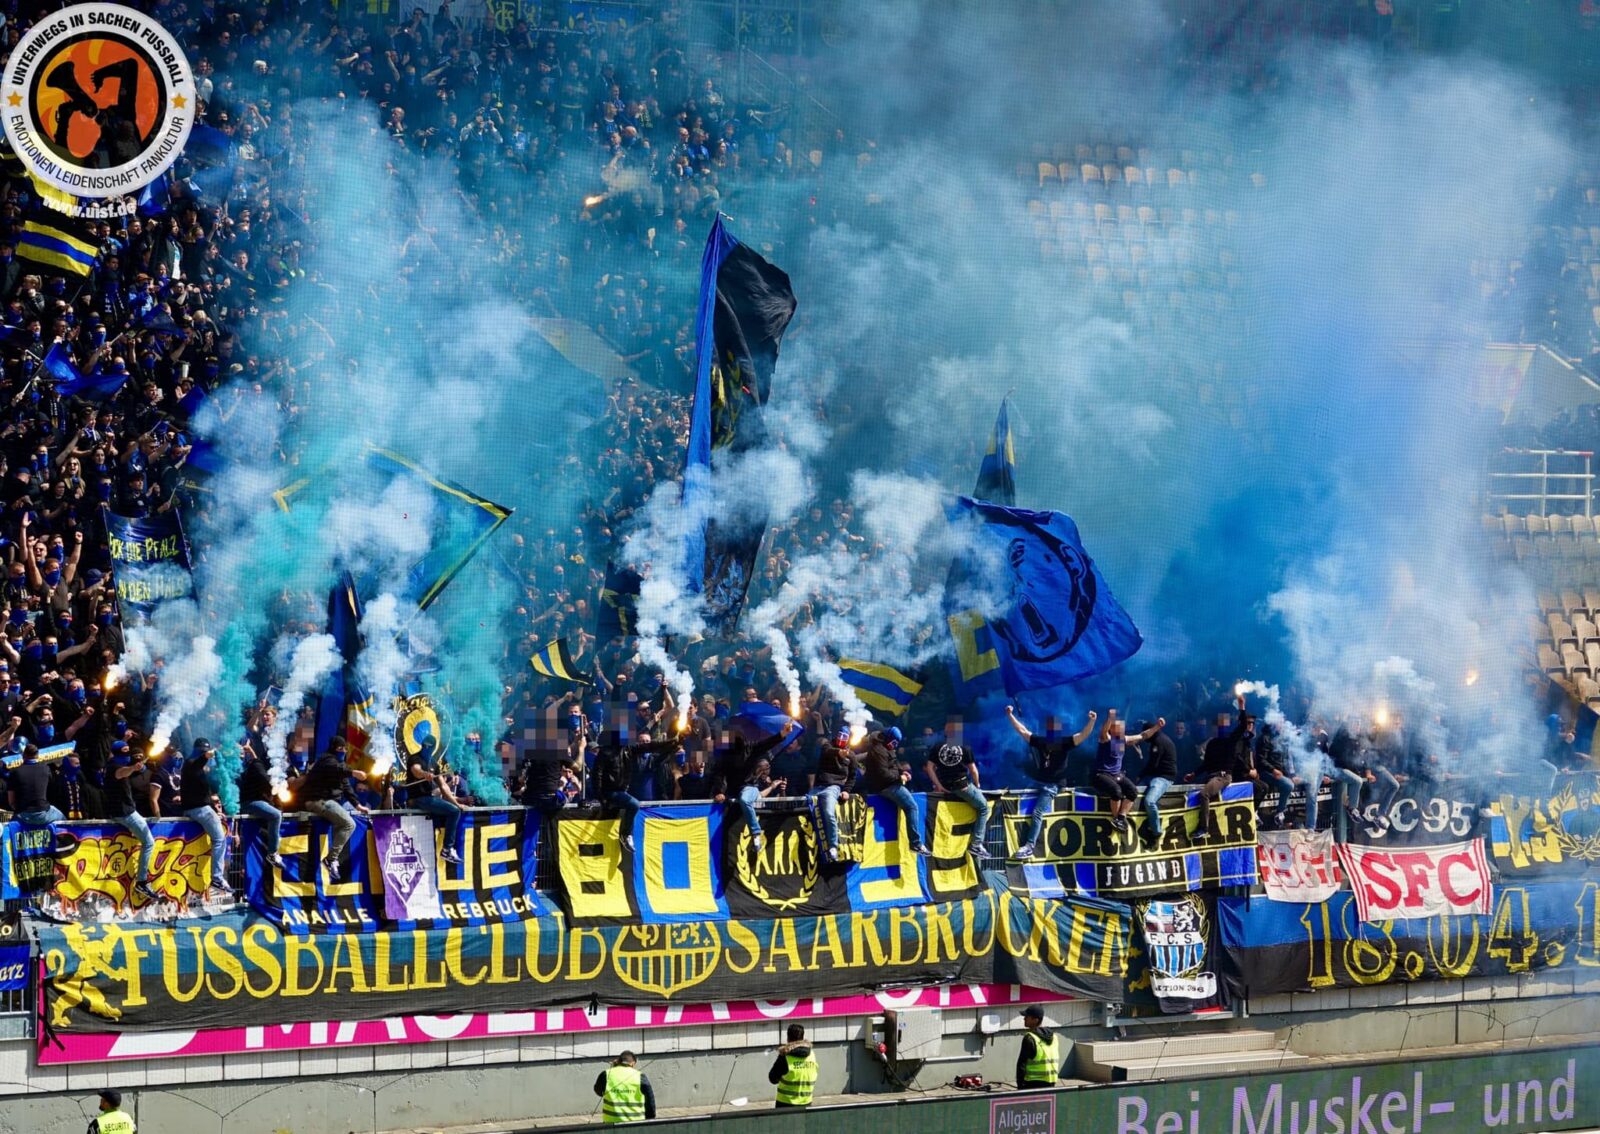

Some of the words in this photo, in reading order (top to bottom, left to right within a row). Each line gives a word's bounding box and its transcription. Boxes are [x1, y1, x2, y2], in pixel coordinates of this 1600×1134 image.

[1361, 797, 1476, 839] SC95
[387, 862, 424, 873] AUSTRIA
[1104, 860, 1182, 887] JUGEND
[1359, 851, 1482, 911] SFC
[281, 907, 373, 926] ANAILLE
[441, 893, 538, 919] REBRUCK
[119, 911, 607, 1008] FUSSBALLCLUB
[1117, 1090, 1200, 1134] Bei
[1232, 1071, 1455, 1134] Muskel-
[1483, 1058, 1576, 1127] und
[998, 1109, 1048, 1131] Allgäuer
